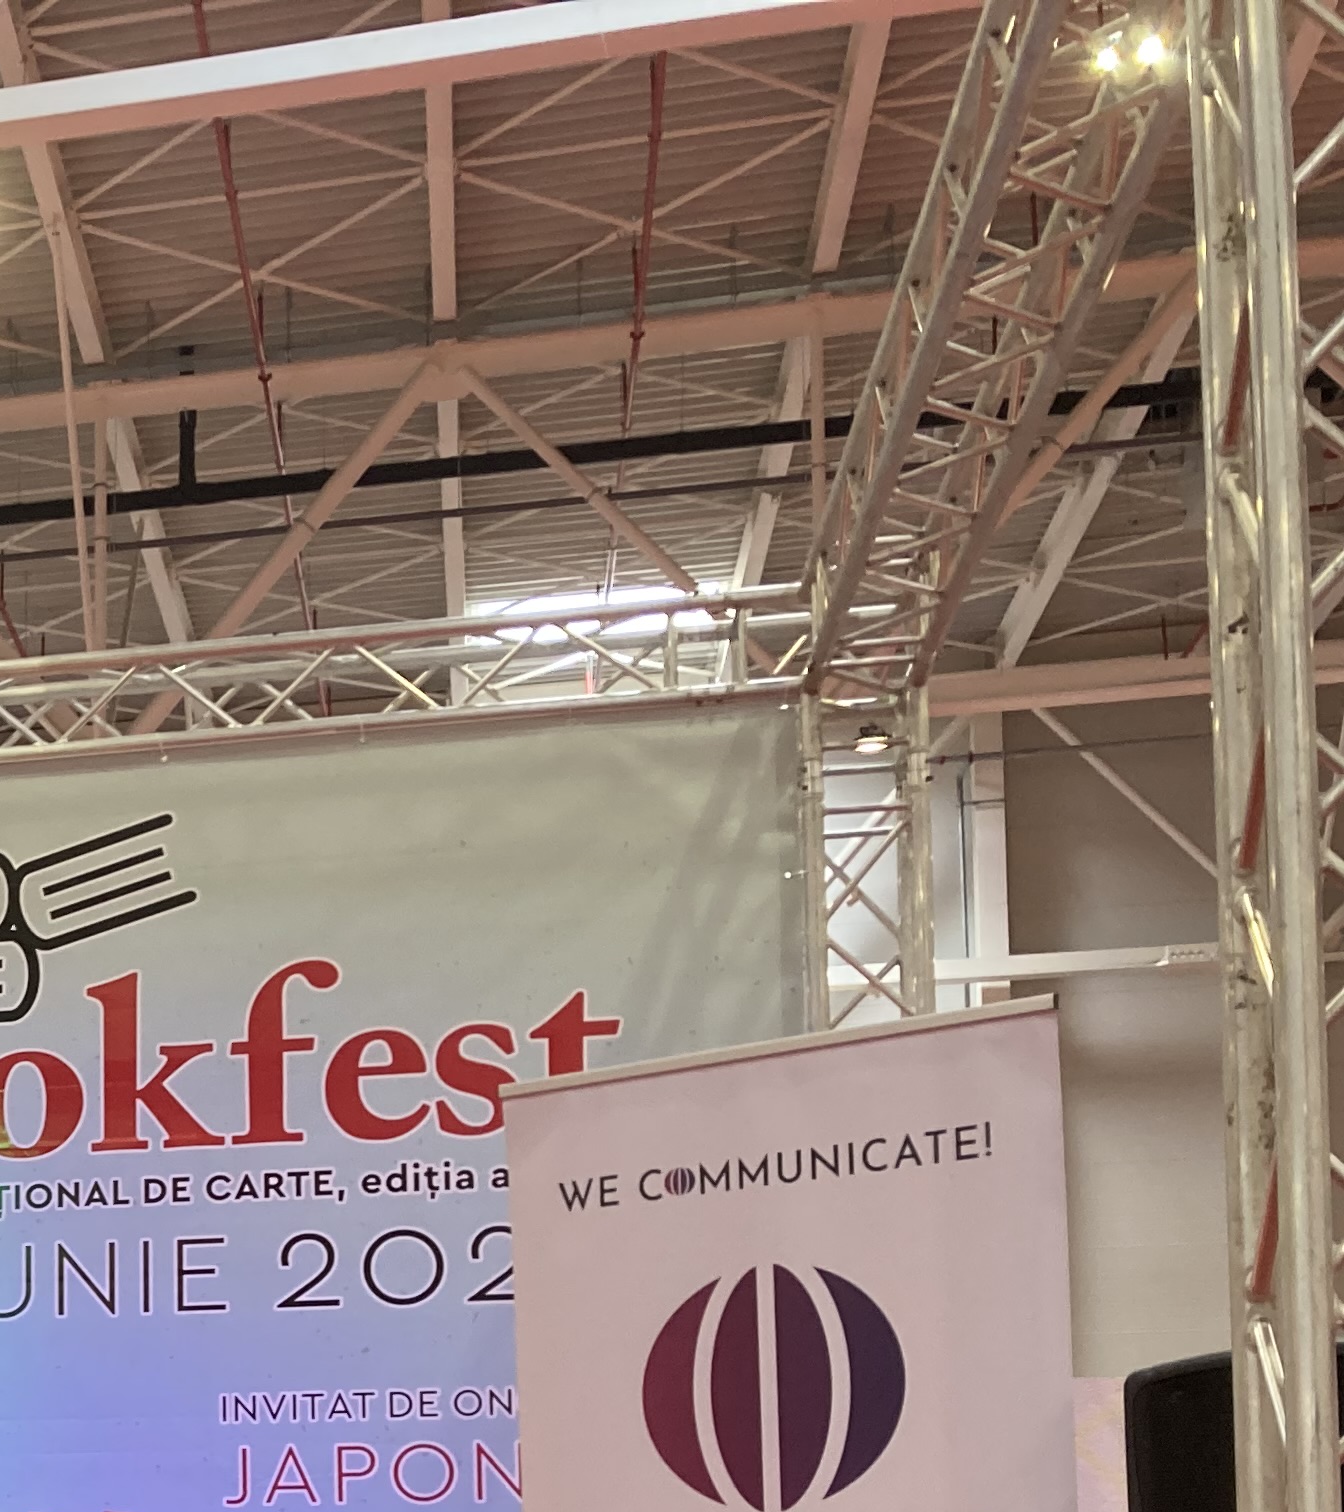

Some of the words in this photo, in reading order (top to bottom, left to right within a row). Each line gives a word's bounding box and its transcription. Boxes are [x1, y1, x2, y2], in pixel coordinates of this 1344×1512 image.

[143, 1176, 191, 1204] DE
[206, 1170, 346, 1203] CARTE,
[361, 1161, 476, 1200] ediția
[491, 1168, 510, 1188] a
[558, 1175, 620, 1213] WE
[638, 1121, 993, 1202] COMMUNICATE!
[220, 1392, 376, 1423] INVITAT
[388, 1390, 439, 1418] DE
